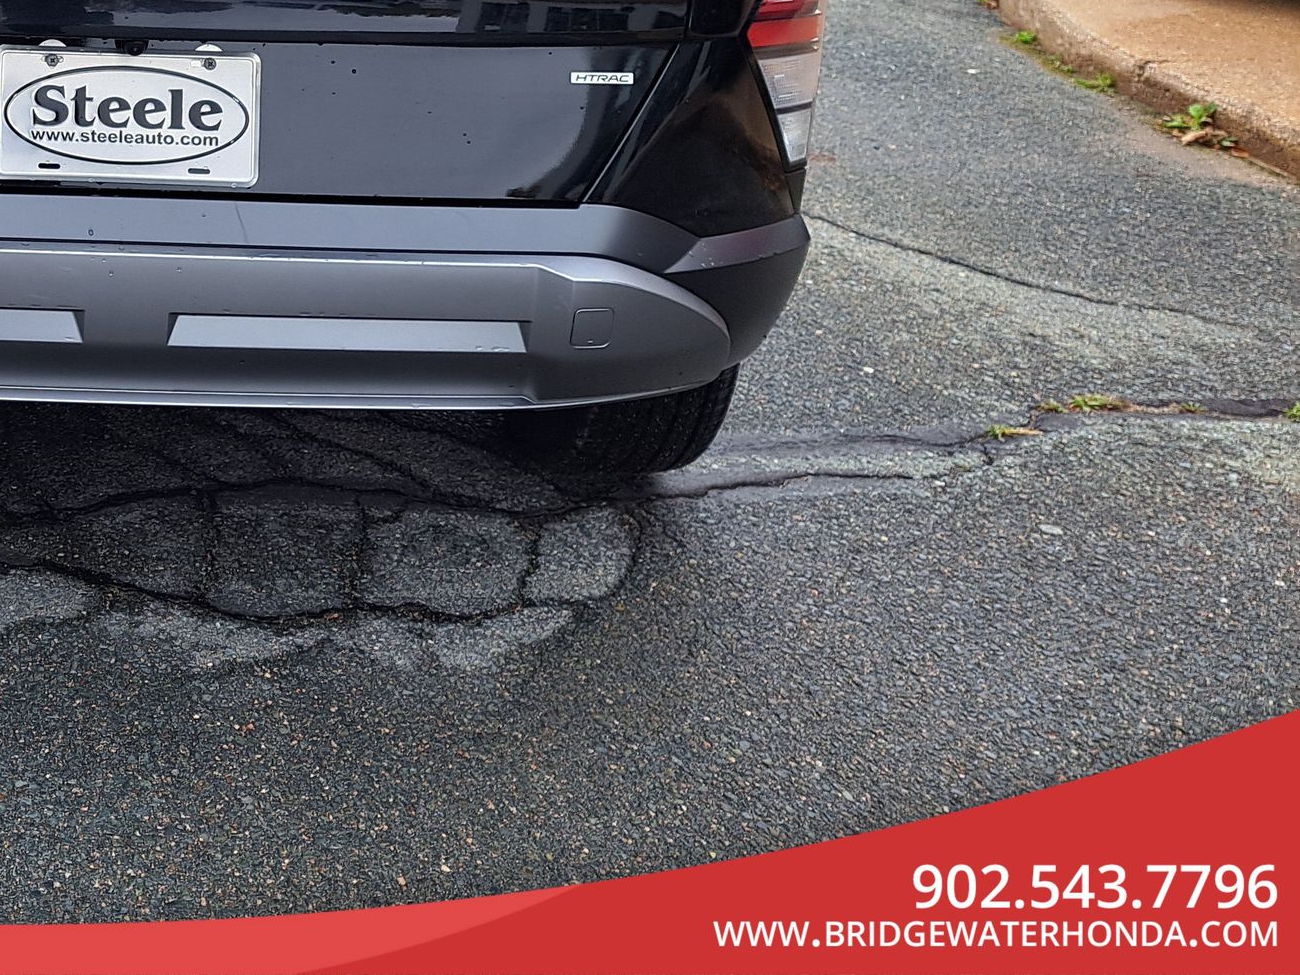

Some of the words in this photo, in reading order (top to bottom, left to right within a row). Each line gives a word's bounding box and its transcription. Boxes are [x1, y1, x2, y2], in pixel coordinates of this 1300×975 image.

[575, 73, 630, 83] HTRAC
[32, 84, 224, 132] Steele
[30, 129, 220, 147] www.steeleauto.com
